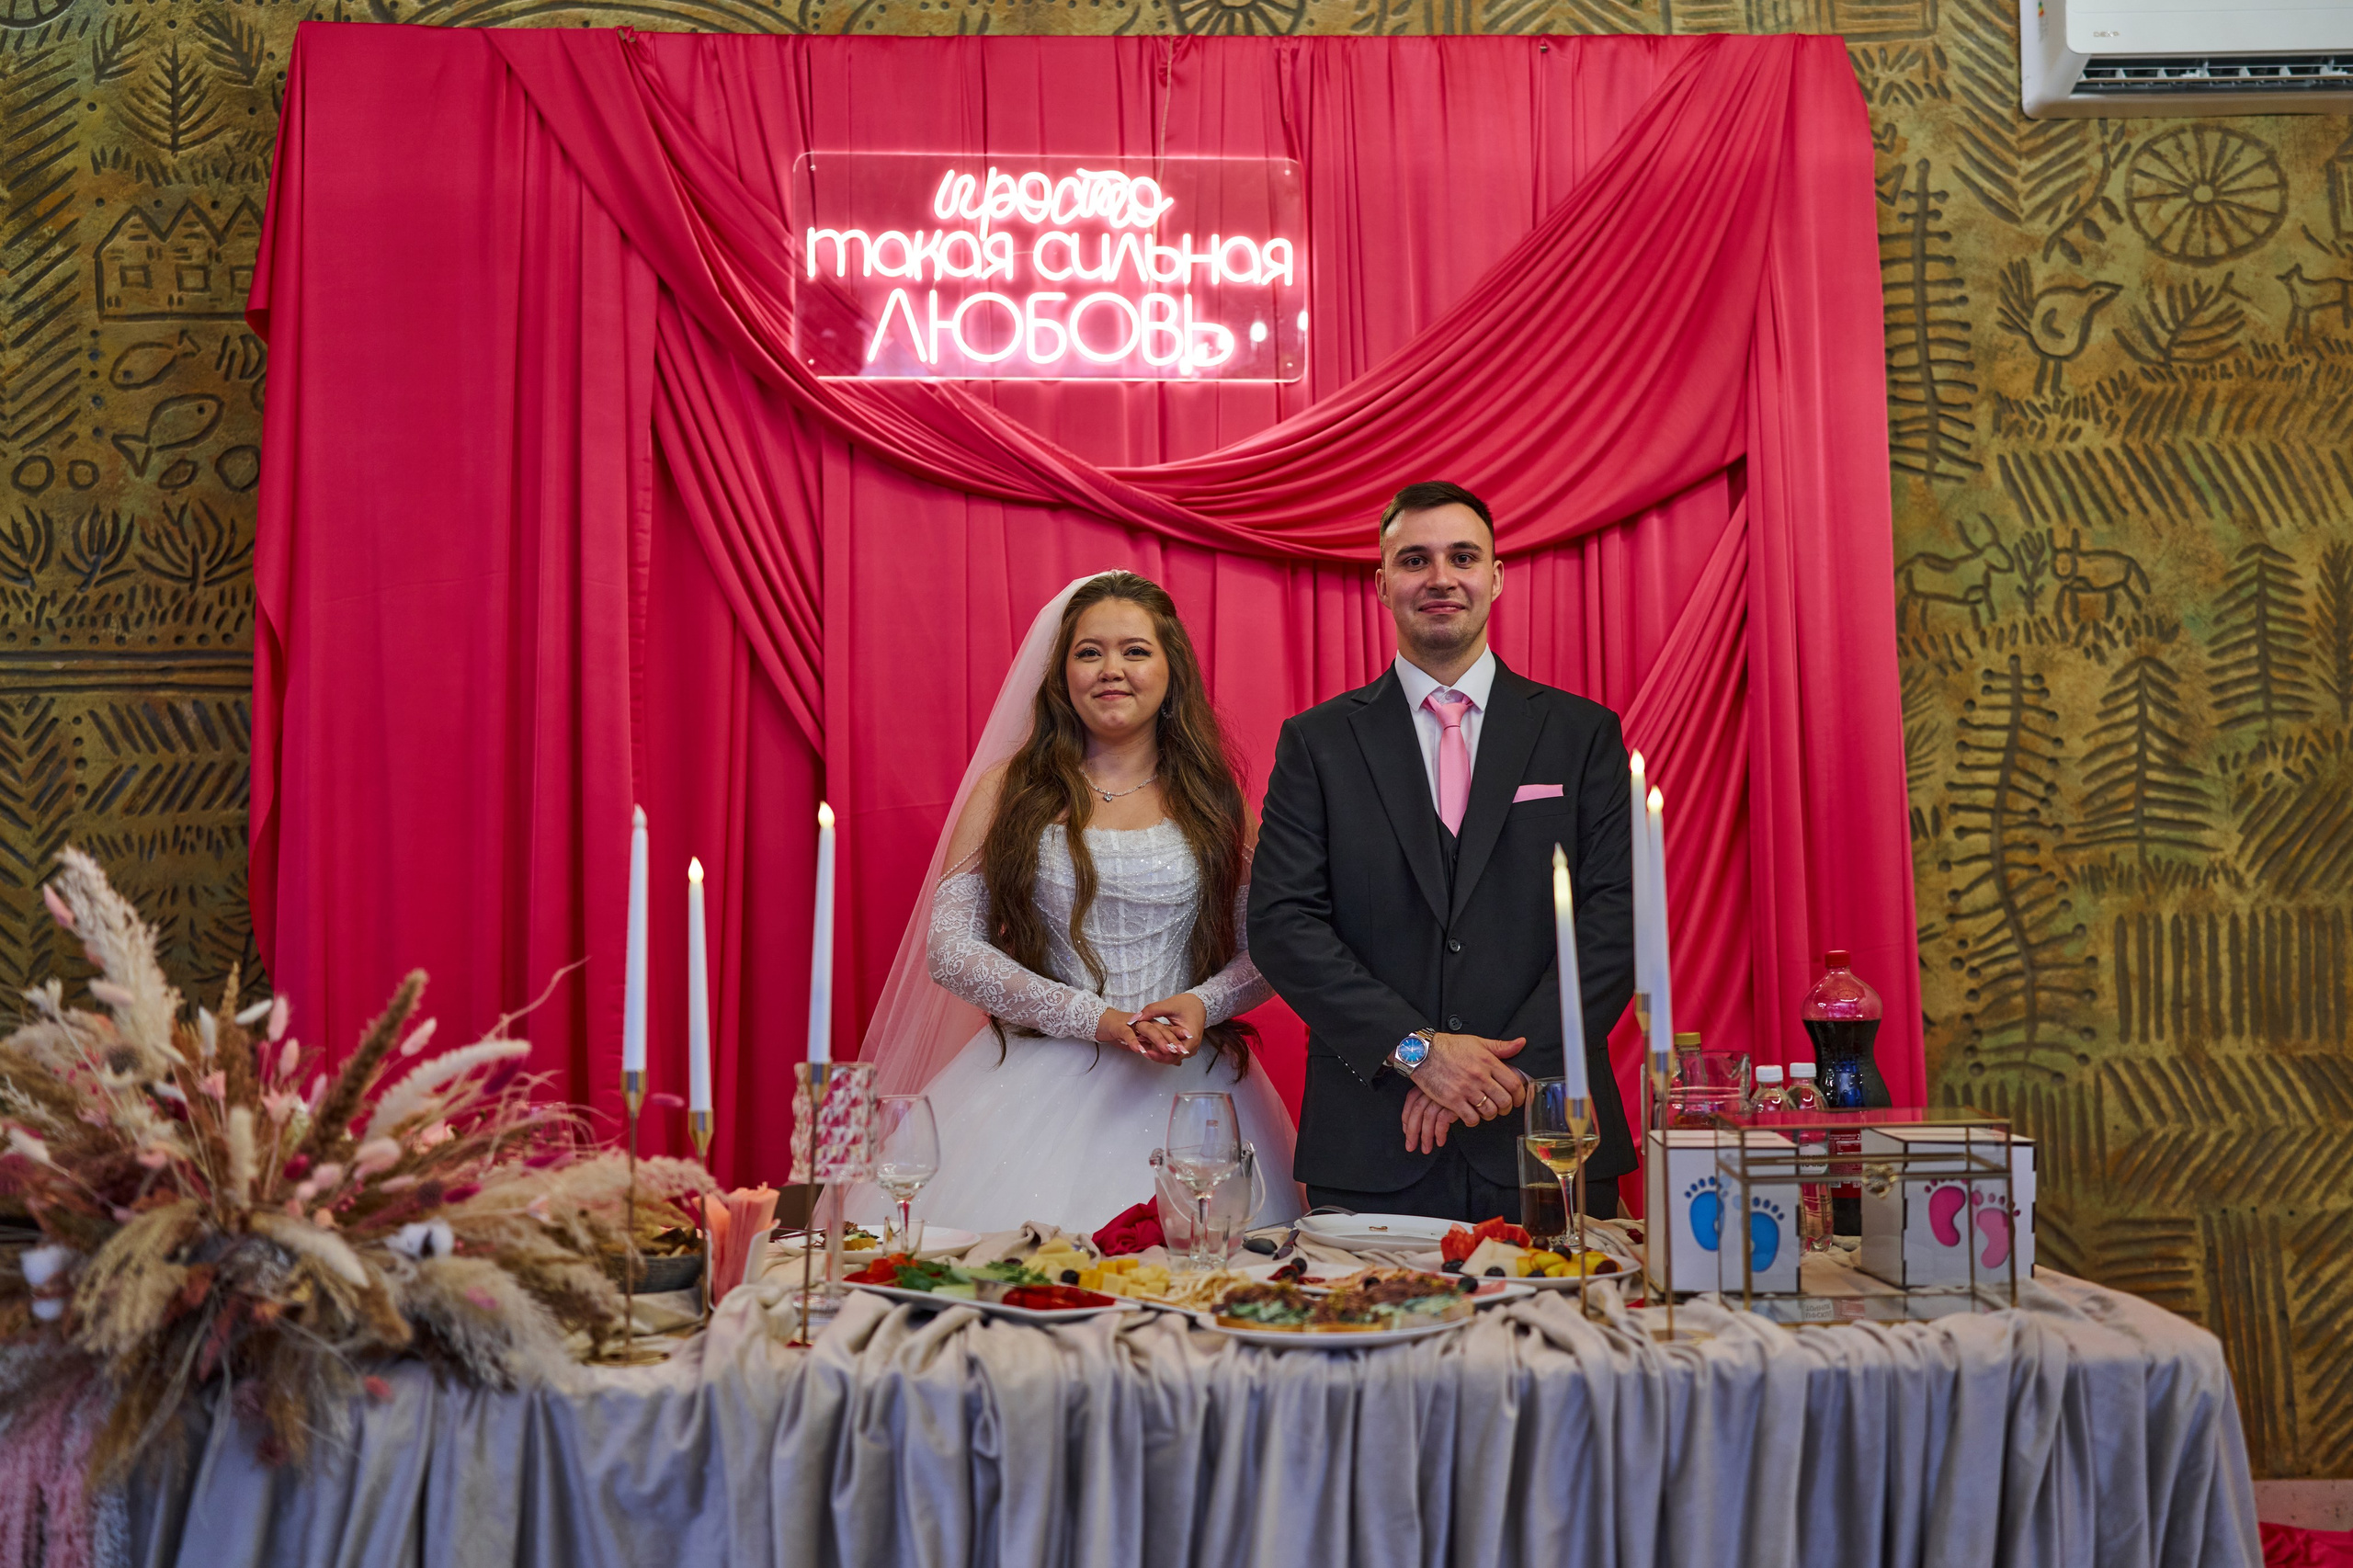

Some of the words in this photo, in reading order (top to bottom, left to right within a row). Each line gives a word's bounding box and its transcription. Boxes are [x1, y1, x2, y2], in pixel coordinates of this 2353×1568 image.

[806, 226, 1014, 281] такая
[1032, 231, 1293, 287] сильная
[866, 288, 1235, 369] ЛЮБОВЬ
